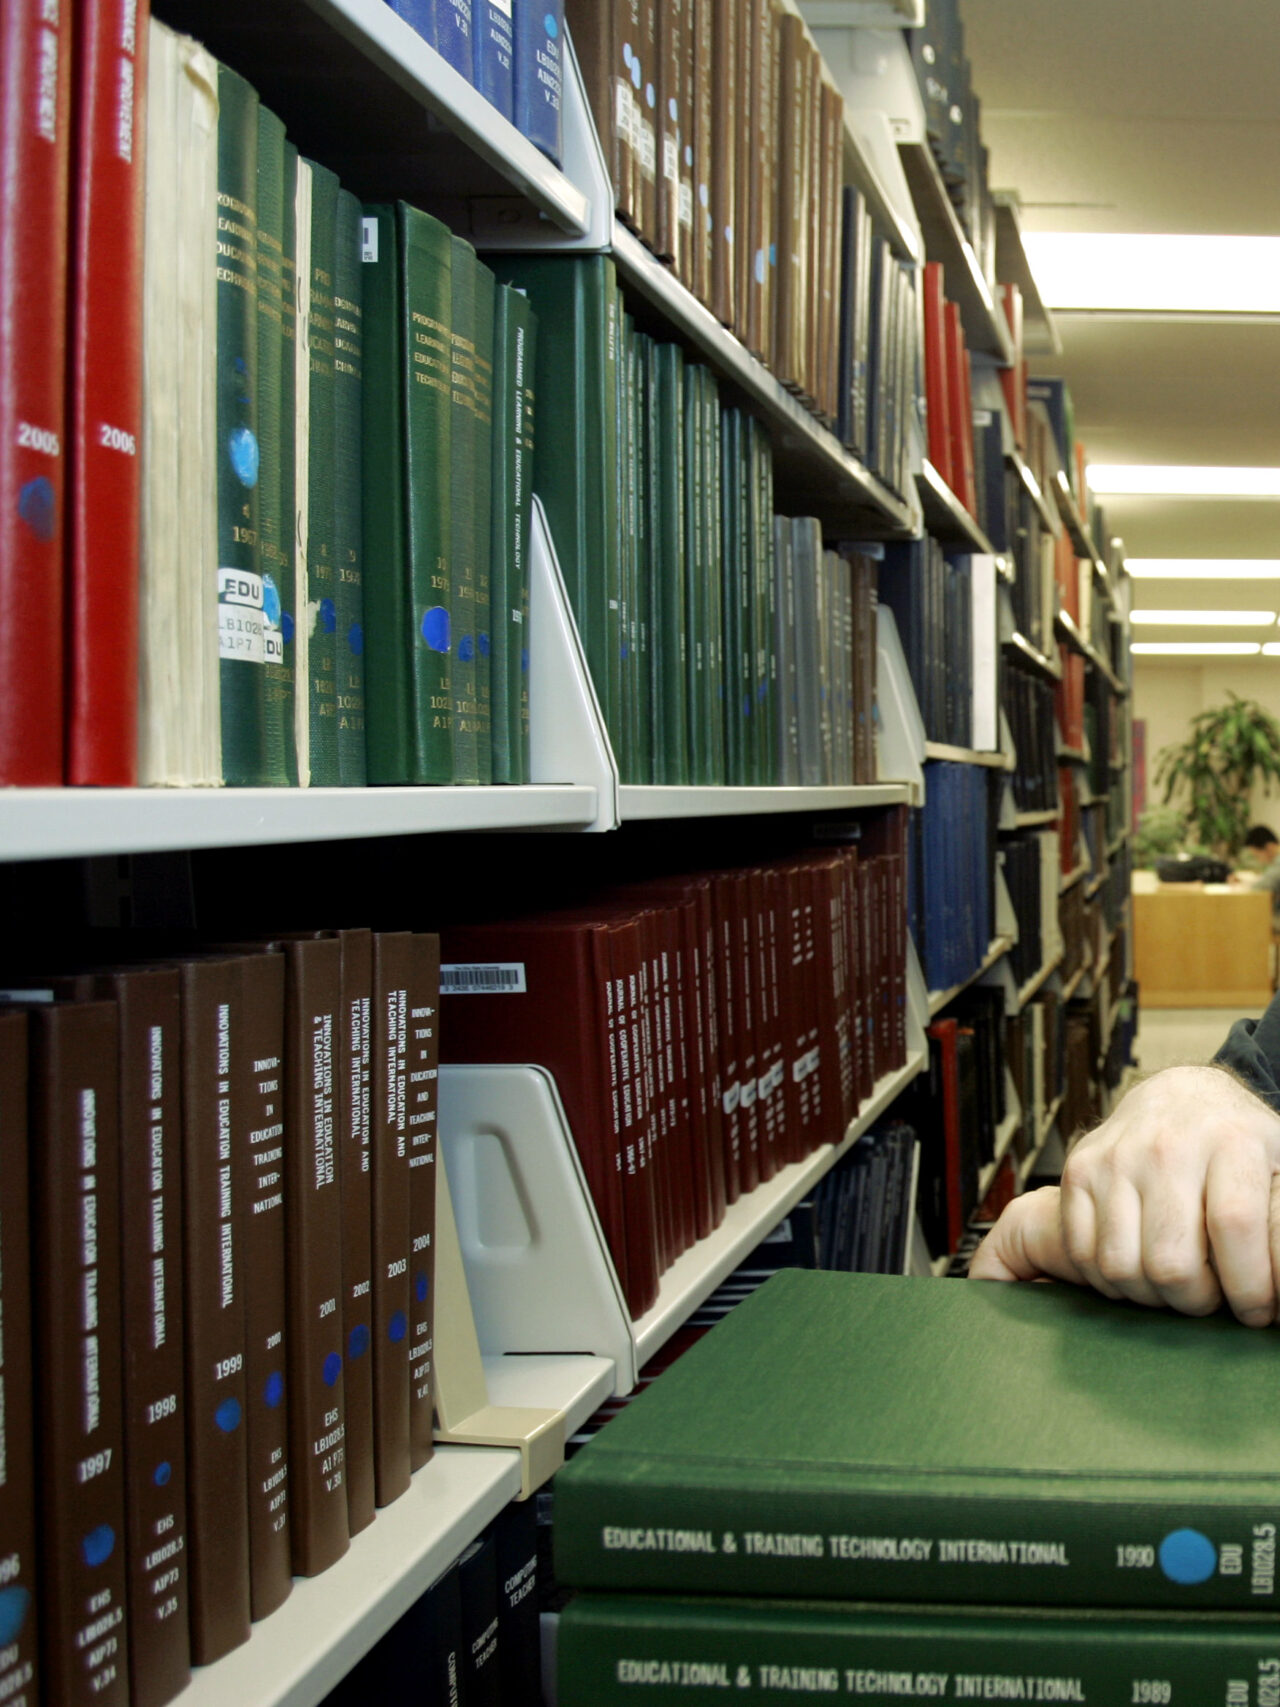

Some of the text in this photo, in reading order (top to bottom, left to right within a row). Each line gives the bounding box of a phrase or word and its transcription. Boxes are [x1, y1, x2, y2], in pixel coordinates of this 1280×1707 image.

[515, 327, 524, 387] PROGRAMMED
[515, 390, 523, 434] LEARNING
[18, 422, 60, 457] 2005
[101, 424, 137, 457] 2006
[514, 449, 523, 507] EDUCATIONAL
[513, 513, 522, 569] TECHNOLOGY
[225, 578, 260, 600] EDU
[263, 638, 282, 655] DU
[616, 979, 625, 1012] JOURNAL
[415, 1028, 432, 1039] TIONS
[618, 1015, 626, 1025] OF
[352, 999, 361, 1138] TEACHING INTERNATIONAL
[388, 991, 397, 1124] TEACHING INTERNATIONAL
[420, 1050, 427, 1060] IN
[619, 1029, 630, 1081] COOPERATIVE
[259, 1080, 278, 1094] TIONS
[362, 998, 371, 1172] INNOVATIONS IN EDUCATION AND
[397, 990, 407, 1157] INNOVATIONS IN EDUCATION AND
[266, 1104, 274, 1117] IN
[313, 1016, 325, 1190] & TEACHING INTERNATIONAL
[323, 1014, 334, 1184] INNOVATIONS IN EDUCATION
[417, 1091, 429, 1103] AND
[623, 1084, 632, 1127] EDUCATION
[82, 1088, 96, 1168] INNOVATIONS
[250, 1123, 284, 1144] EDUCATION
[410, 1111, 436, 1125] TEACHING
[218, 1004, 234, 1309] INNOVATIONS IN EDUCATION TRAINING INTERNATIONAL
[254, 1147, 282, 1166] TRAINING
[410, 1153, 434, 1168] NATIONAL
[151, 1026, 166, 1349] INNOVATIONS IN EDUCATION TRAINING INTERNATIONAL
[259, 1171, 281, 1189] INTER-
[83, 1194, 98, 1265] EDUCATION
[413, 1233, 430, 1252] 2004
[388, 1258, 407, 1279] 2003
[353, 1280, 370, 1298] 2002
[319, 1298, 337, 1319] 2001
[266, 1331, 282, 1350] 2000
[416, 1321, 428, 1337] EHS
[409, 1338, 432, 1361] LB1028.5
[215, 1353, 243, 1381] 1999
[85, 1335, 100, 1435] INTERNATIONAL
[148, 1394, 177, 1424] 1998
[324, 1408, 338, 1427] EHS
[314, 1423, 345, 1455] LB1028.5
[79, 1449, 113, 1484] 1997
[271, 1447, 283, 1464] EHS
[156, 1514, 174, 1535] EHS
[145, 1536, 184, 1571] LB1028.5
[602, 1526, 1155, 1569] EDUCATIONAL & TRAINING TECHNOLOGY INTERNATIONAL 1990
[1219, 1543, 1243, 1576] EDU
[1251, 1522, 1276, 1595] LB1028.5
[0, 1553, 20, 1583] 96
[509, 1574, 536, 1608] TEACHER
[157, 1597, 178, 1621] V.35
[616, 1658, 1172, 1705] EDUCATIONAL & TRAINING TECHNOLOGY INTERNATIONAL 1989
